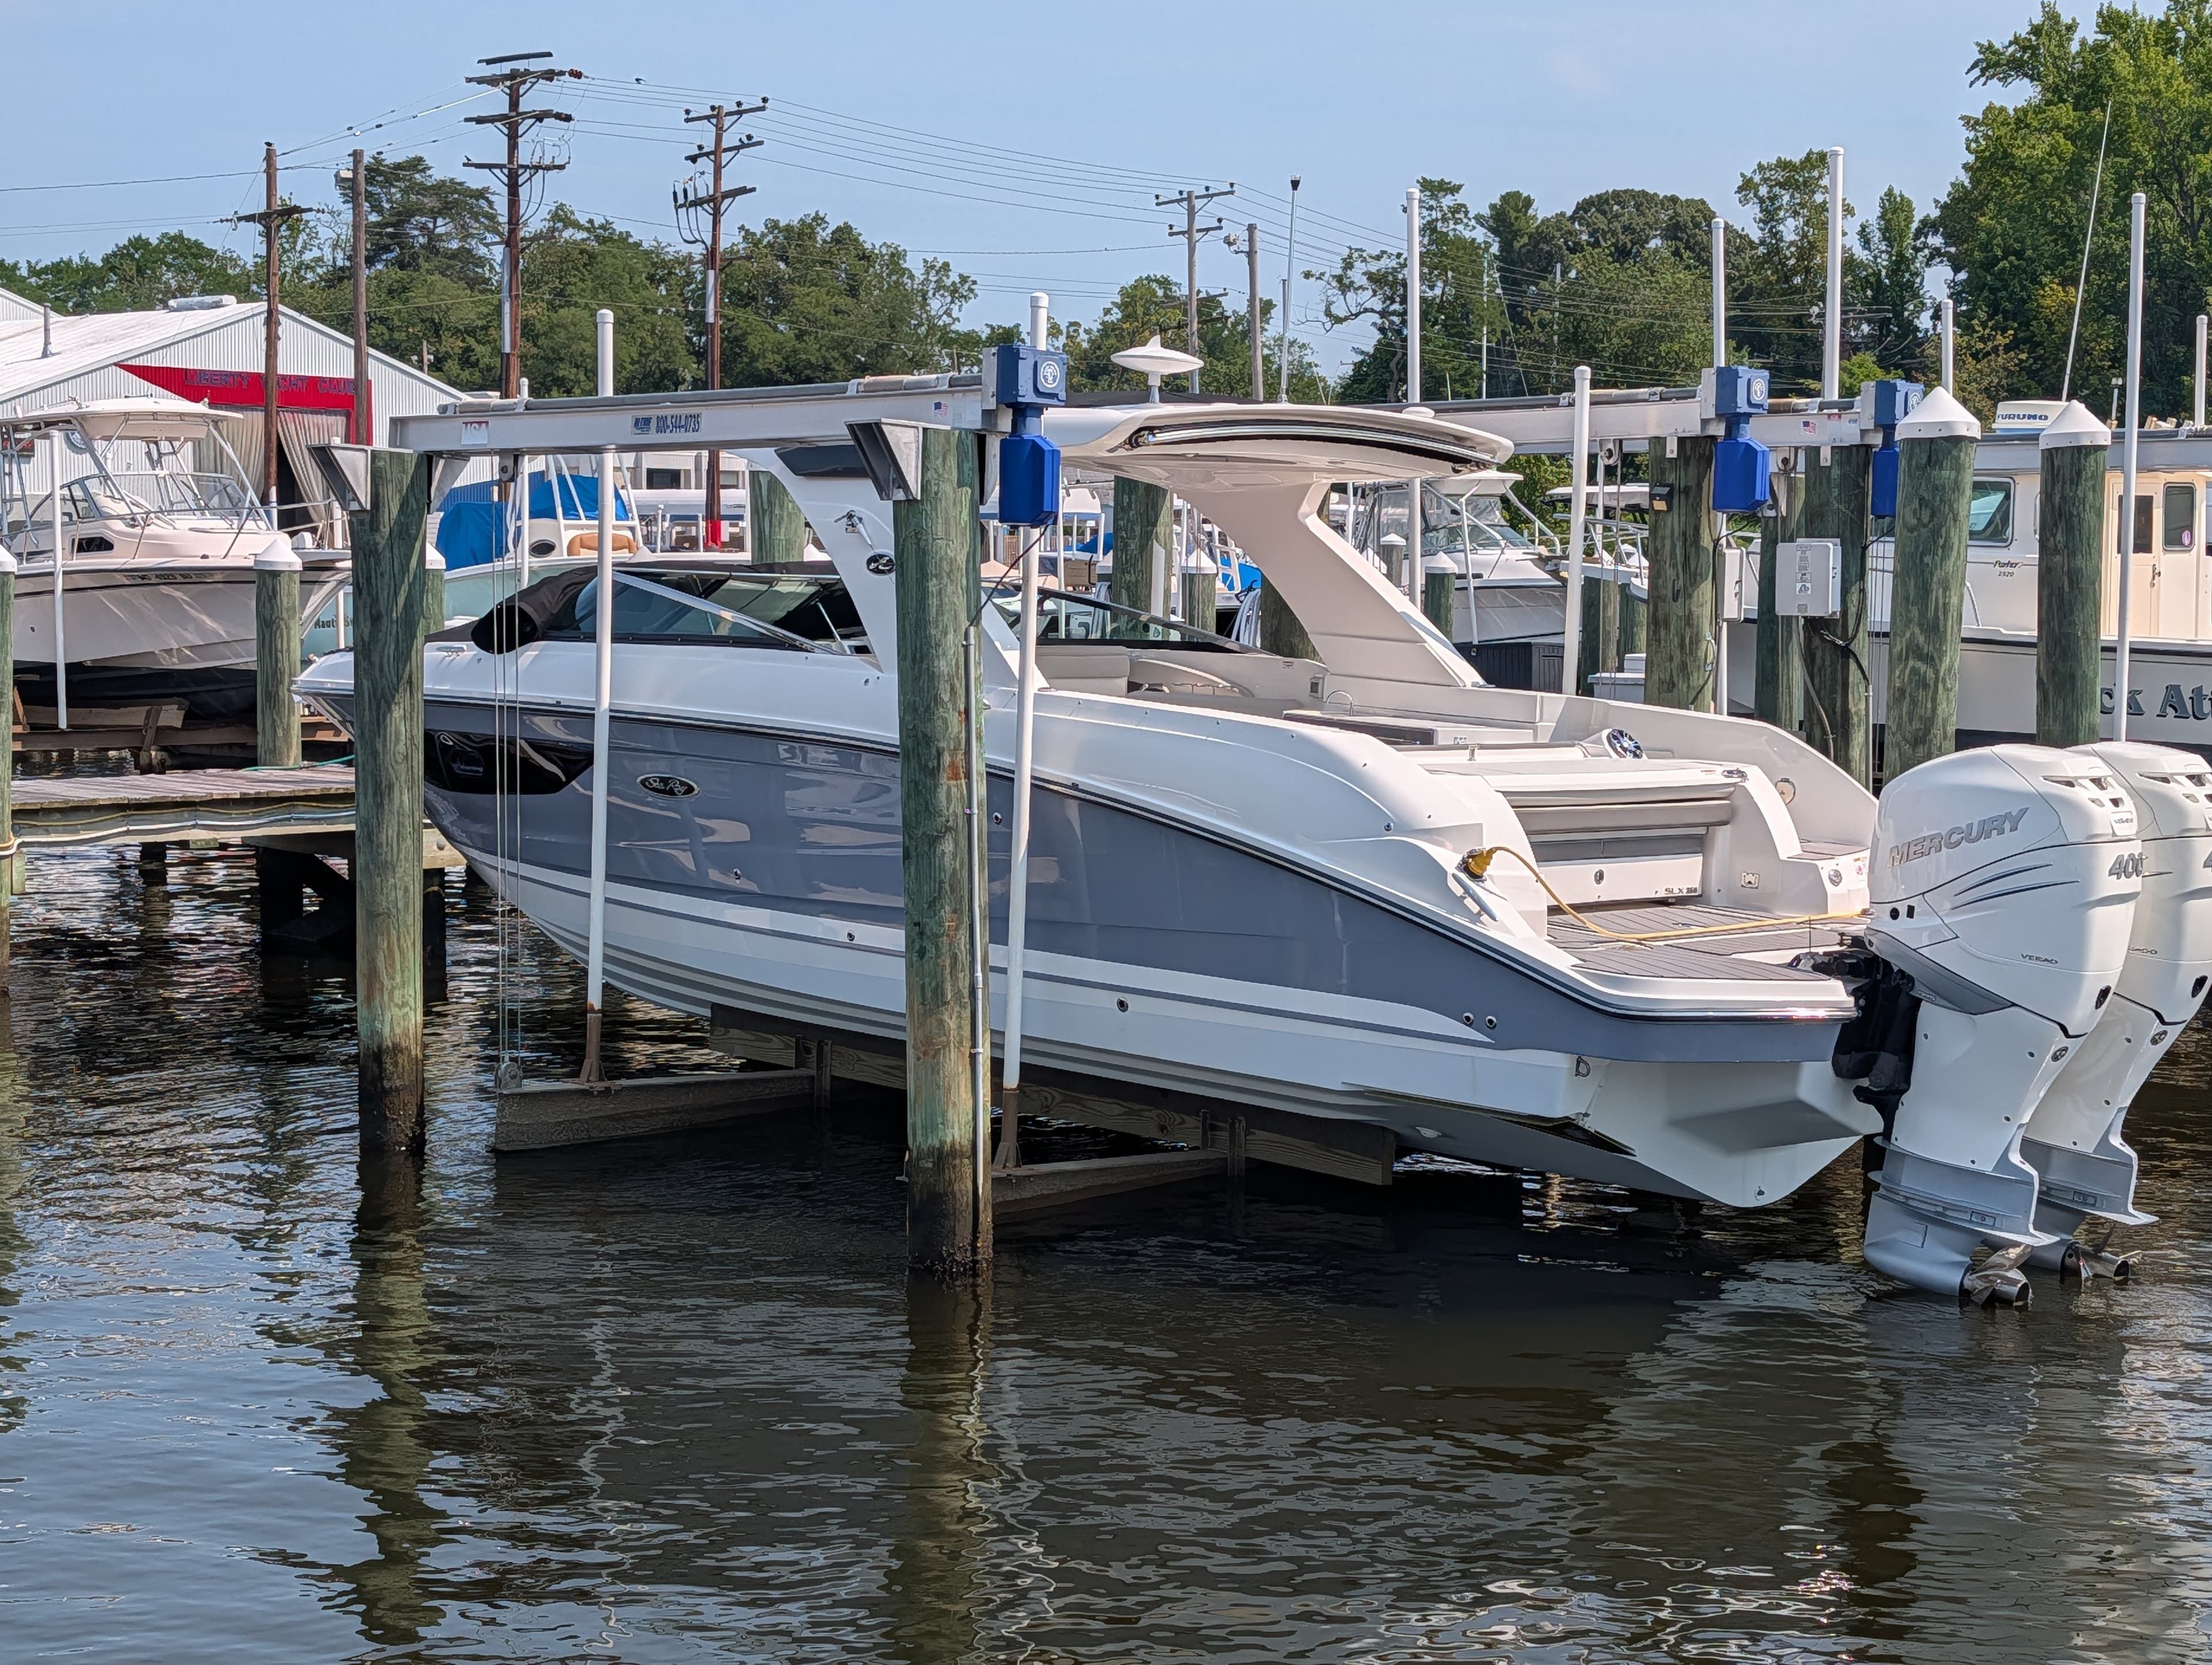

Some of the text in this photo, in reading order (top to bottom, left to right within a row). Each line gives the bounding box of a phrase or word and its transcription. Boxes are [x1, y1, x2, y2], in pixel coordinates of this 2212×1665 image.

[185, 370, 249, 388] LIBERTY
[261, 375, 308, 392] YCHT
[2156, 684, 2212, 720] At
[645, 777, 688, 795] Sea Ray
[1888, 807, 2029, 868] MERCURY
